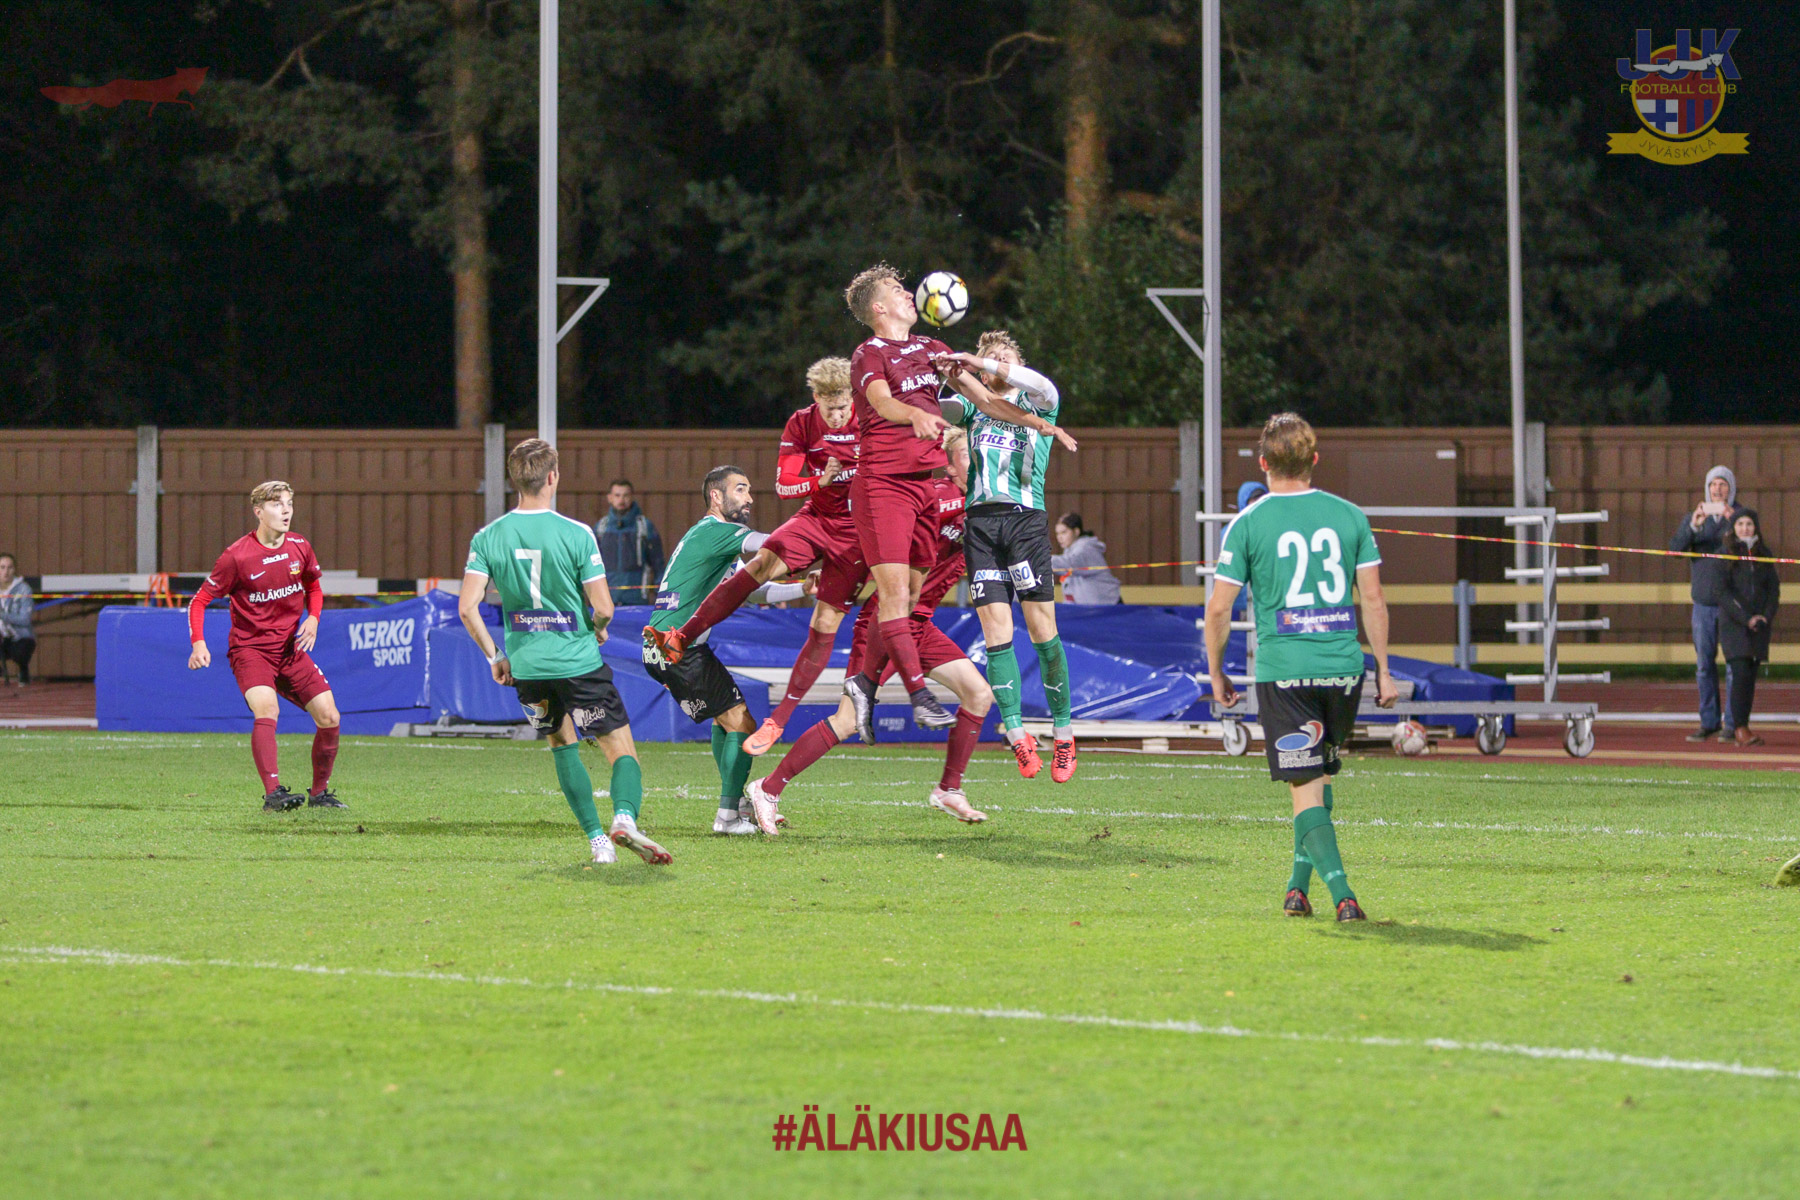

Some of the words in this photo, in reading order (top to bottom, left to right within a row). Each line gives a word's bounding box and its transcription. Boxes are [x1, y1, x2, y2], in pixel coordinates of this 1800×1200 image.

[1277, 527, 1346, 608] 23
[515, 549, 543, 609] 7
[970, 582, 986, 600] 62
[520, 614, 572, 626] Supermarket
[1292, 611, 1351, 626] Supermarket
[349, 618, 415, 651] KERKO
[373, 645, 412, 667] SPORT
[732, 687, 742, 700] 2
